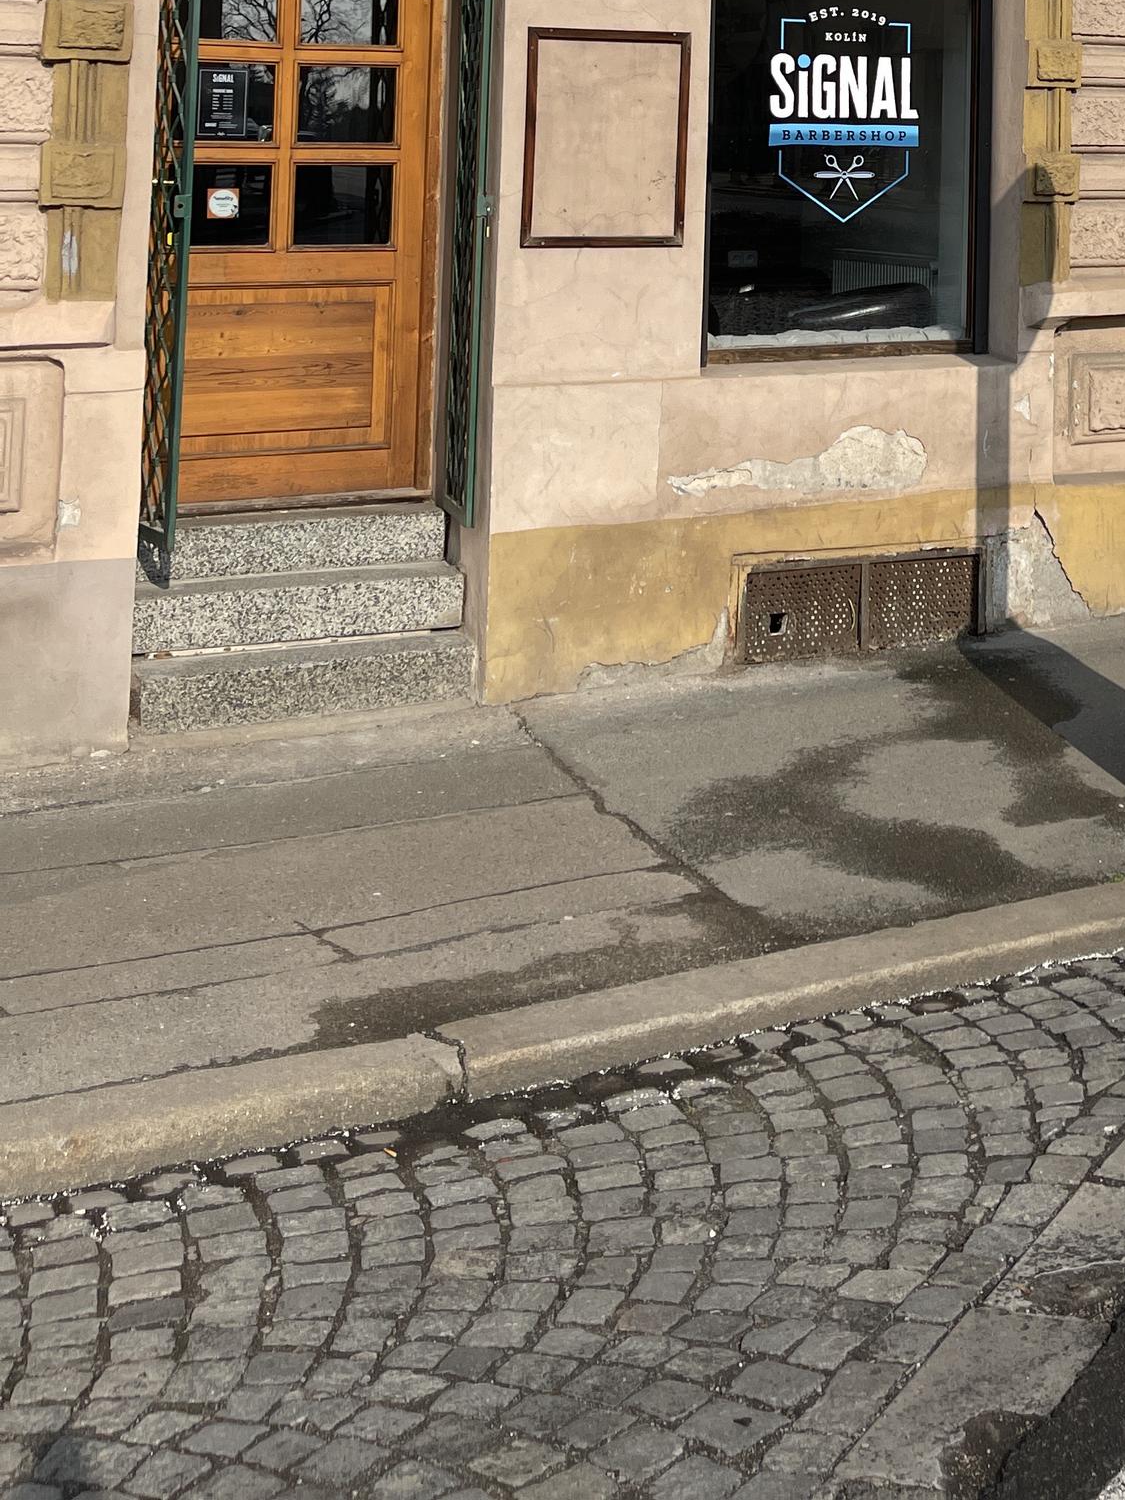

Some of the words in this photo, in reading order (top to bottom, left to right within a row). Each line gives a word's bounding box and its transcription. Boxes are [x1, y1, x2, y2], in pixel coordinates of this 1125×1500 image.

[808, 6, 845, 22] EST.
[852, 8, 887, 26] 2019
[825, 31, 867, 42] KOLÍN
[782, 129, 907, 141] BARBERSHOP
